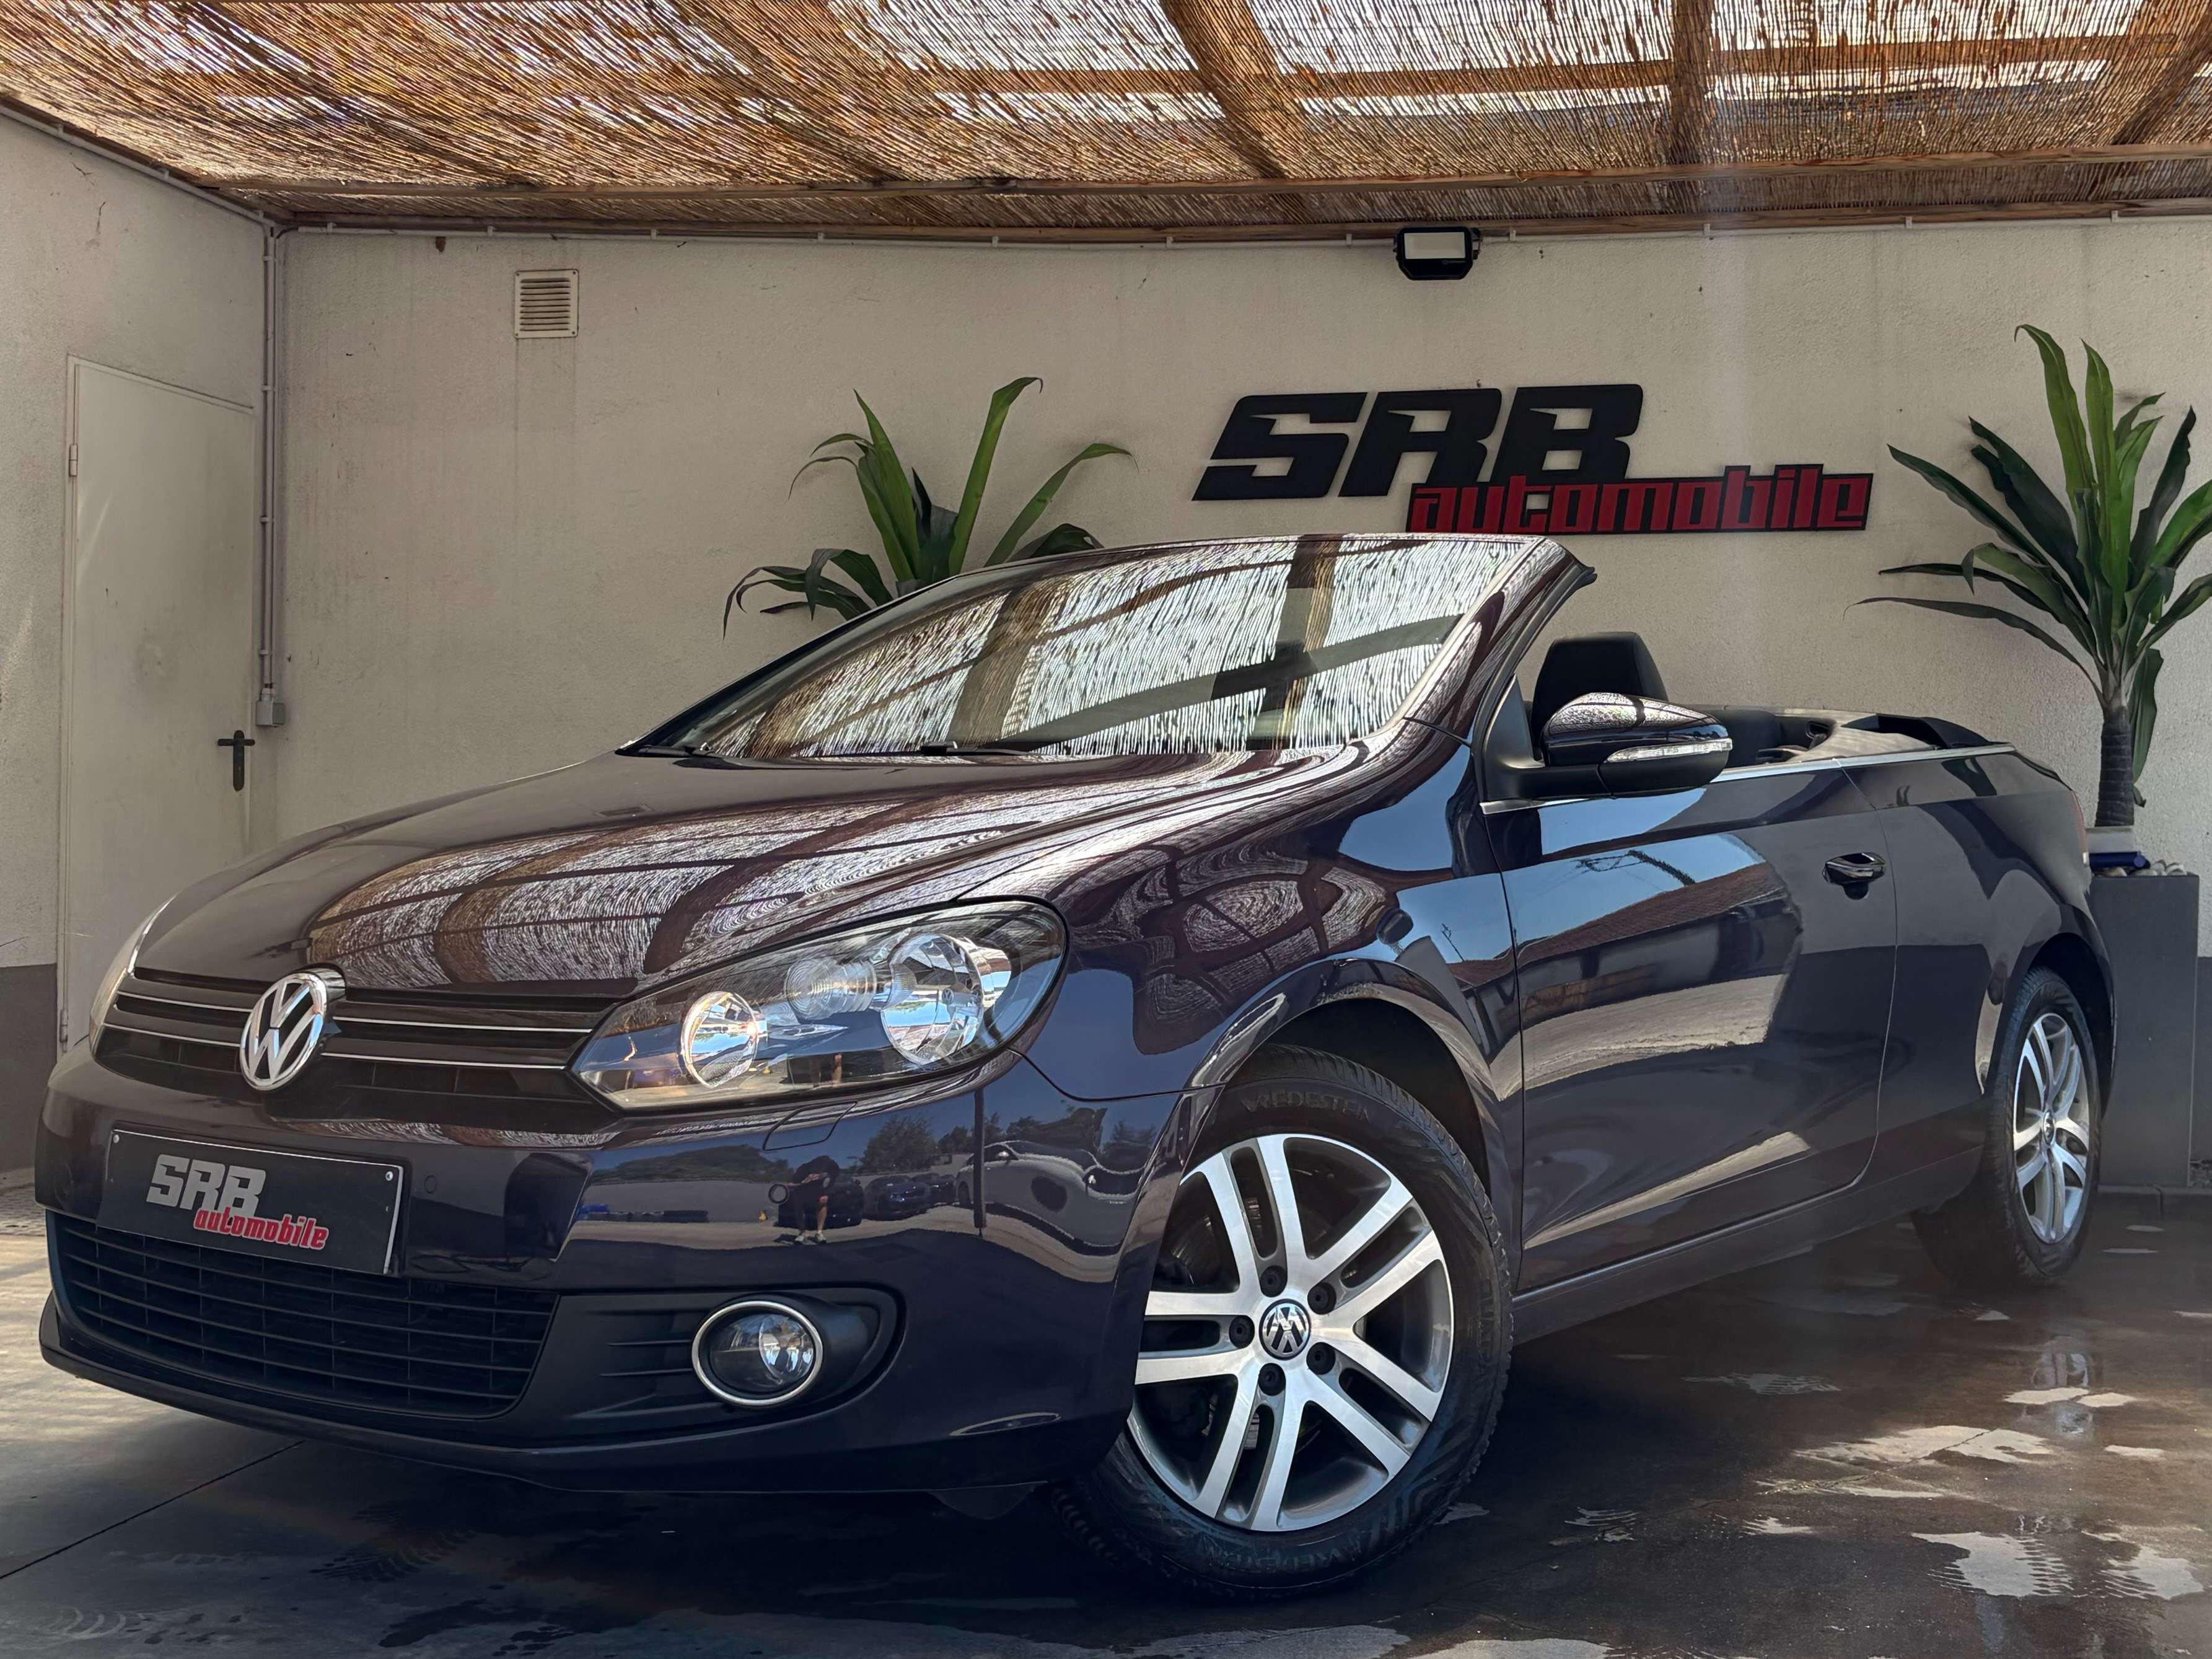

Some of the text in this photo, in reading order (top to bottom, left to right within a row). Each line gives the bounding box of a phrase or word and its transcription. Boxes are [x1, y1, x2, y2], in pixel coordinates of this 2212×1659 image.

[1192, 384, 1643, 501] SRB
[1408, 465, 1872, 534] automobile
[240, 972, 327, 1091] VW
[146, 1154, 266, 1217] SRB
[193, 1207, 329, 1250] automobile
[1262, 1302, 1309, 1357] VW
